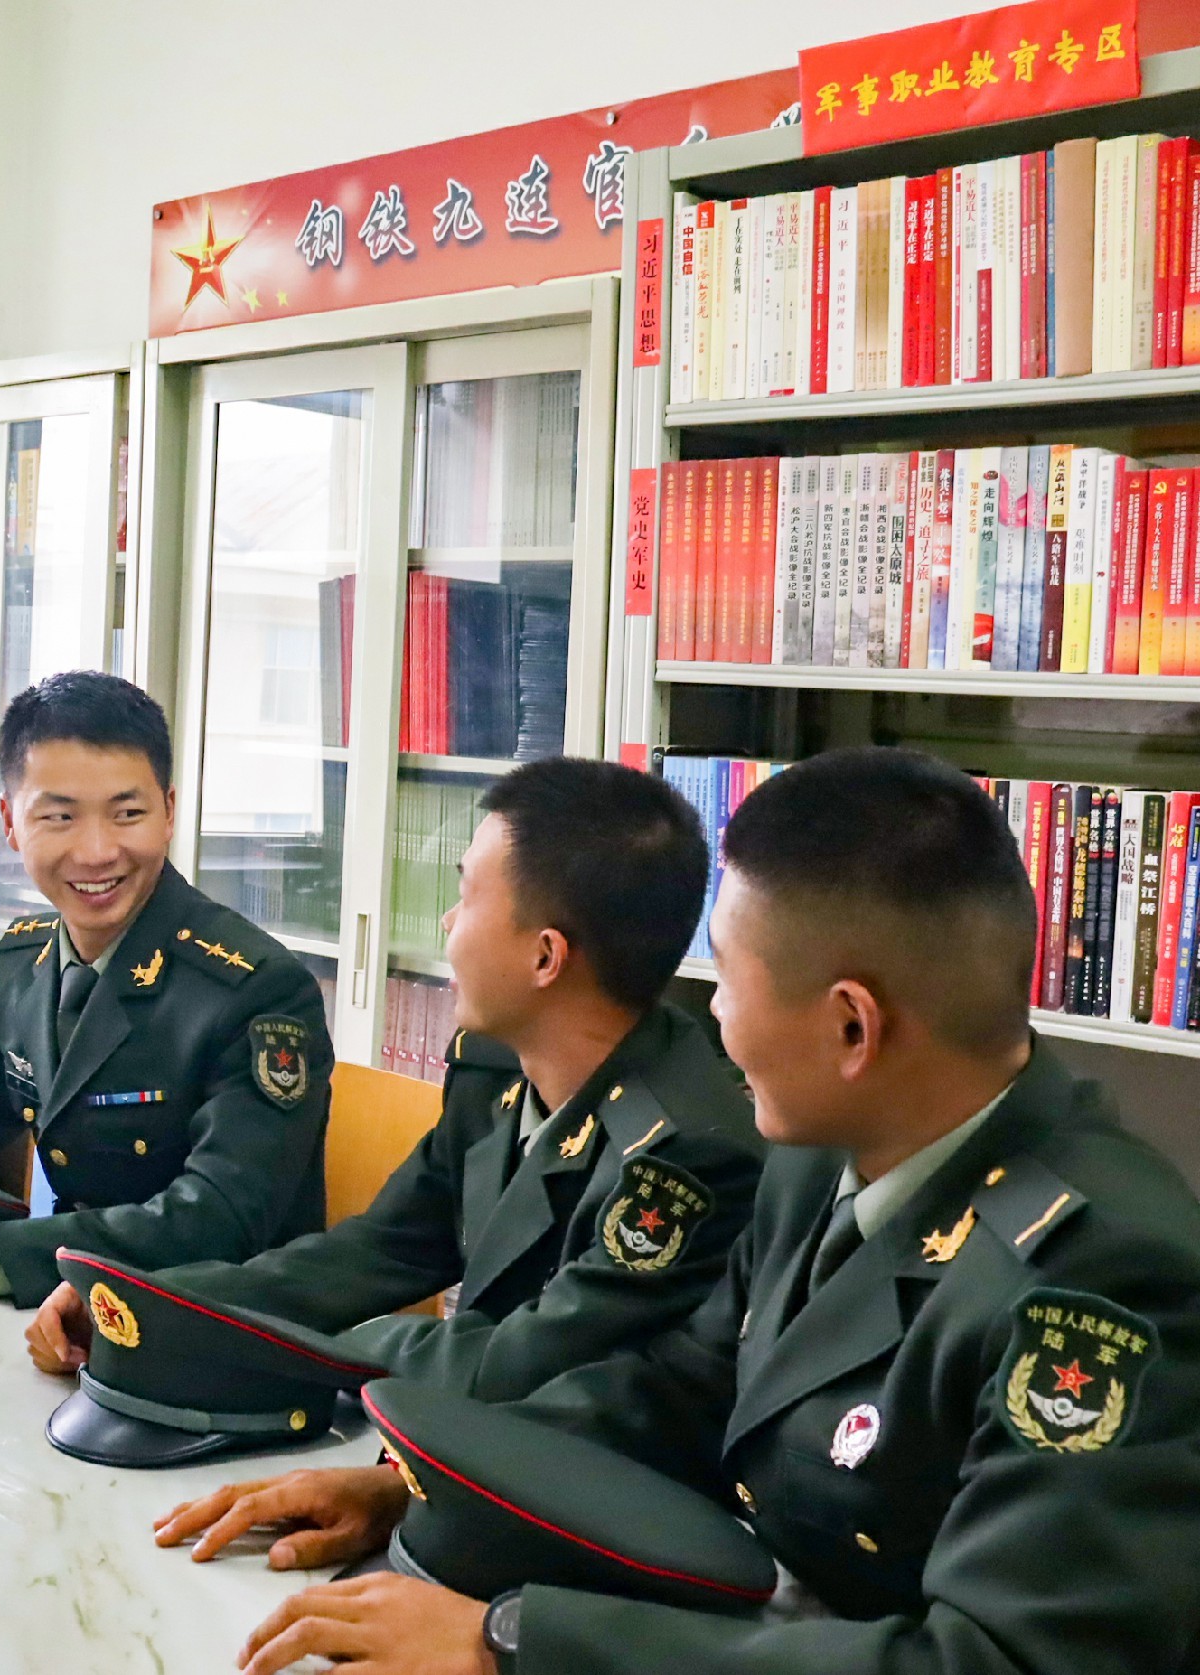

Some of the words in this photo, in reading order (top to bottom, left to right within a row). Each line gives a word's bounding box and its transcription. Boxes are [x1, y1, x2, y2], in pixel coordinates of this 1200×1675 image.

[815, 24, 1125, 124] 军事职业教育专区
[837, 201, 849, 252] 习近平
[966, 178, 977, 222] 平易近人
[682, 226, 694, 275] 中国自信
[907, 200, 918, 266] 习近平在正定
[922, 198, 934, 262] 习近平在正定
[639, 233, 658, 353] 习近平思想
[1078, 458, 1088, 509] 太平洋战争
[981, 487, 996, 542] 走向辉煌
[632, 496, 650, 591] 党史军史
[821, 504, 833, 599] 新四军抗战影像全纪录
[889, 515, 904, 586] 围困太原城
[1050, 533, 1062, 586] 八路军抗战
[1090, 808, 1101, 853] 世界名枪
[1103, 808, 1116, 852] 世界名枪
[1121, 833, 1137, 885] 大国战略
[1140, 853, 1158, 916] 血祭江桥
[1027, 1305, 1148, 1354] 中国人民解放军
